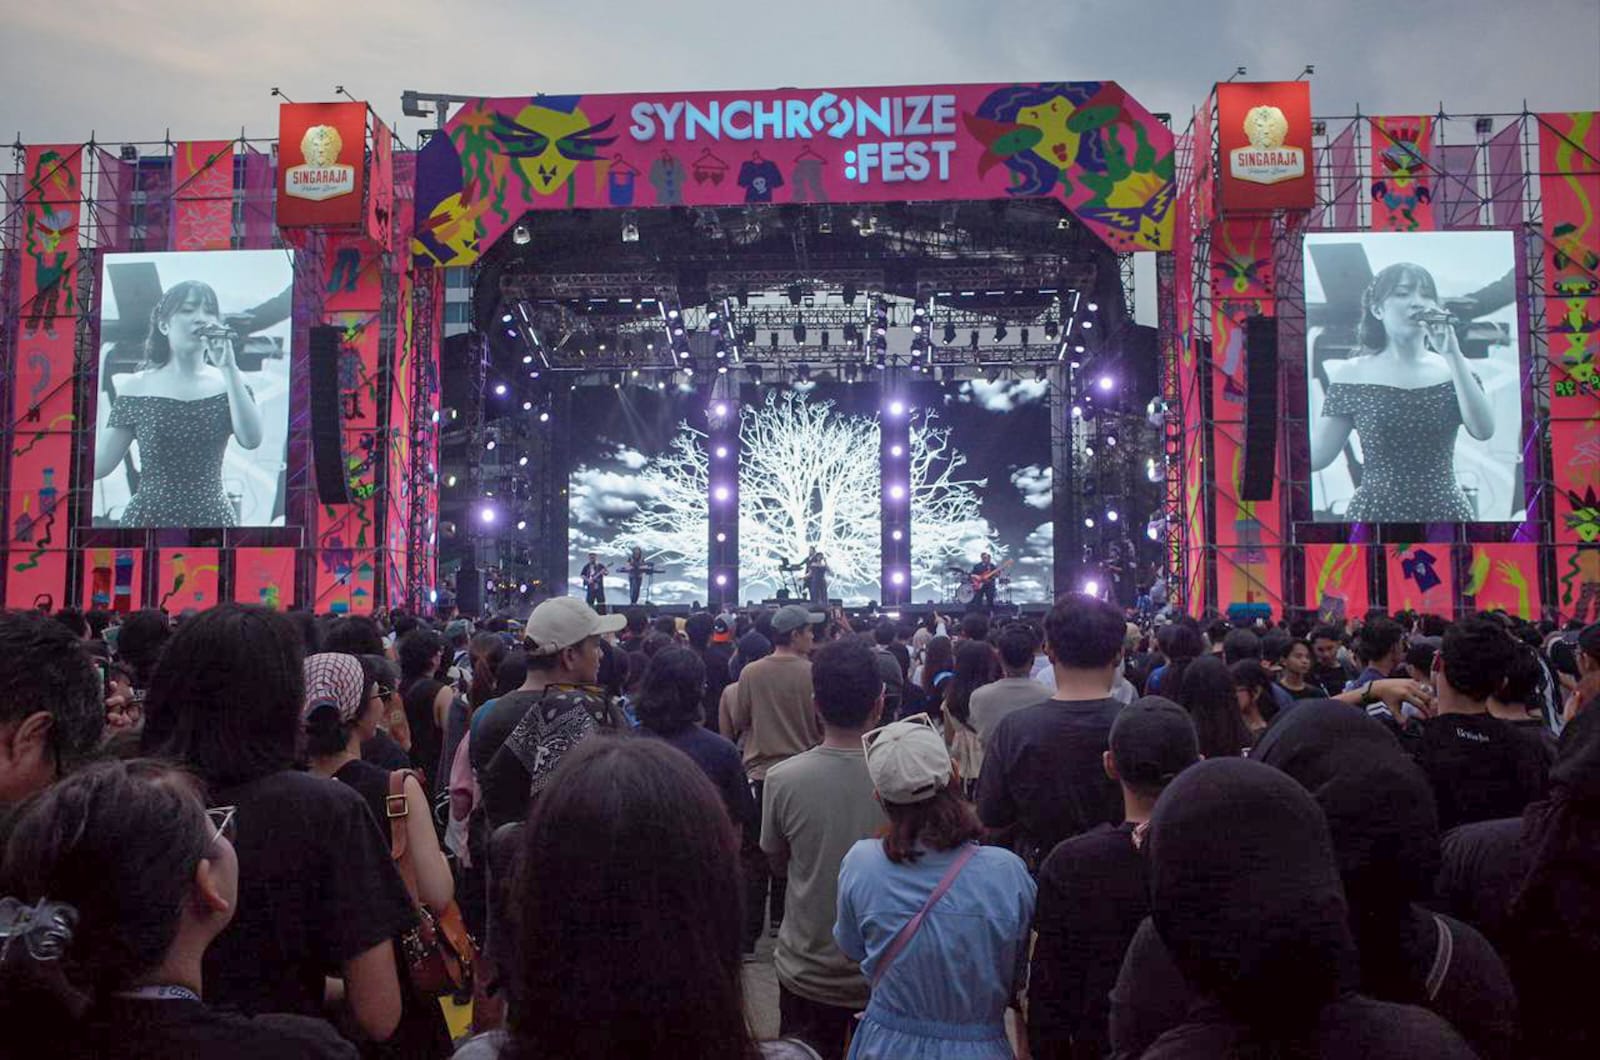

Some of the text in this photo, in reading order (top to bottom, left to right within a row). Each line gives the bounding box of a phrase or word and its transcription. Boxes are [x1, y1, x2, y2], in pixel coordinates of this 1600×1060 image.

[629, 92, 956, 141] SYNCHRONIZE
[1238, 152, 1298, 167] SINGARAJA
[293, 169, 348, 185] SINGARAJA
